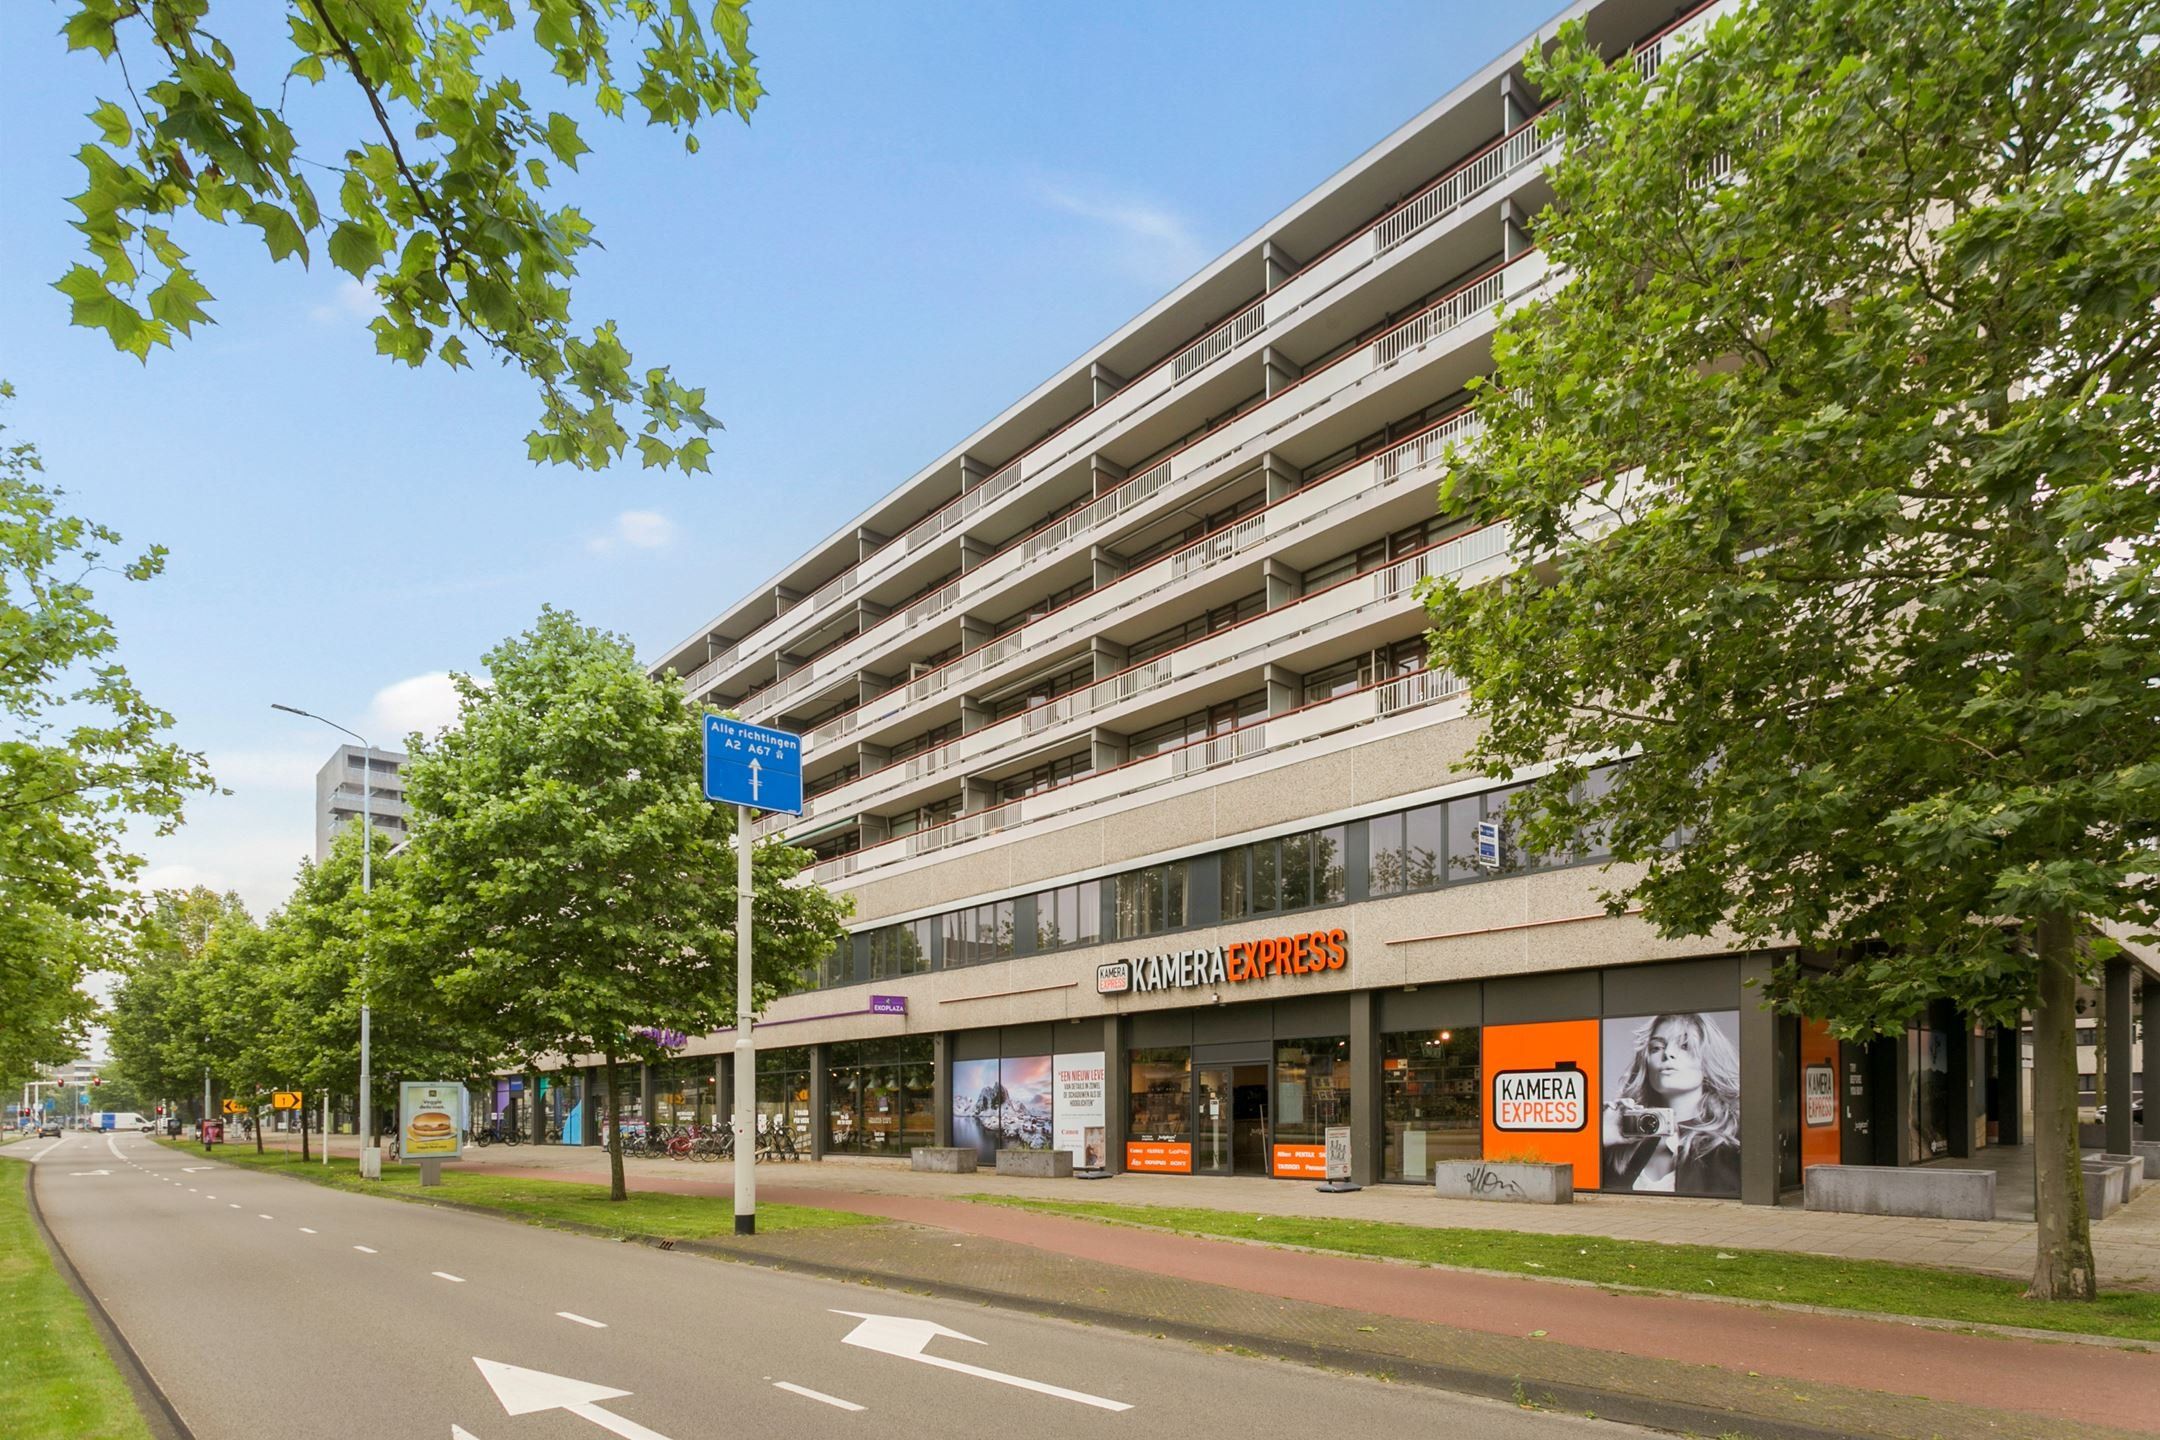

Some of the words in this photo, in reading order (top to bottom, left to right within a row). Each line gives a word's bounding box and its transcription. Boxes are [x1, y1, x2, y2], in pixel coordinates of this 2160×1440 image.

[711, 721, 735, 735] Alle
[738, 729, 797, 749] richtingen
[725, 738, 741, 750] A2
[748, 744, 771, 756] A67
[1100, 966, 1126, 978] KAMERA
[1099, 977, 1126, 990] EXPRESS
[874, 1004, 904, 1012] EKOPLAZA
[1072, 1070, 1090, 1081] NIEUW
[1808, 1073, 1832, 1095] KAMERA
[1502, 1077, 1577, 1100] KAMERA
[1502, 1101, 1577, 1123] EXPRESS
[1808, 1096, 1832, 1118] EXPRESS
